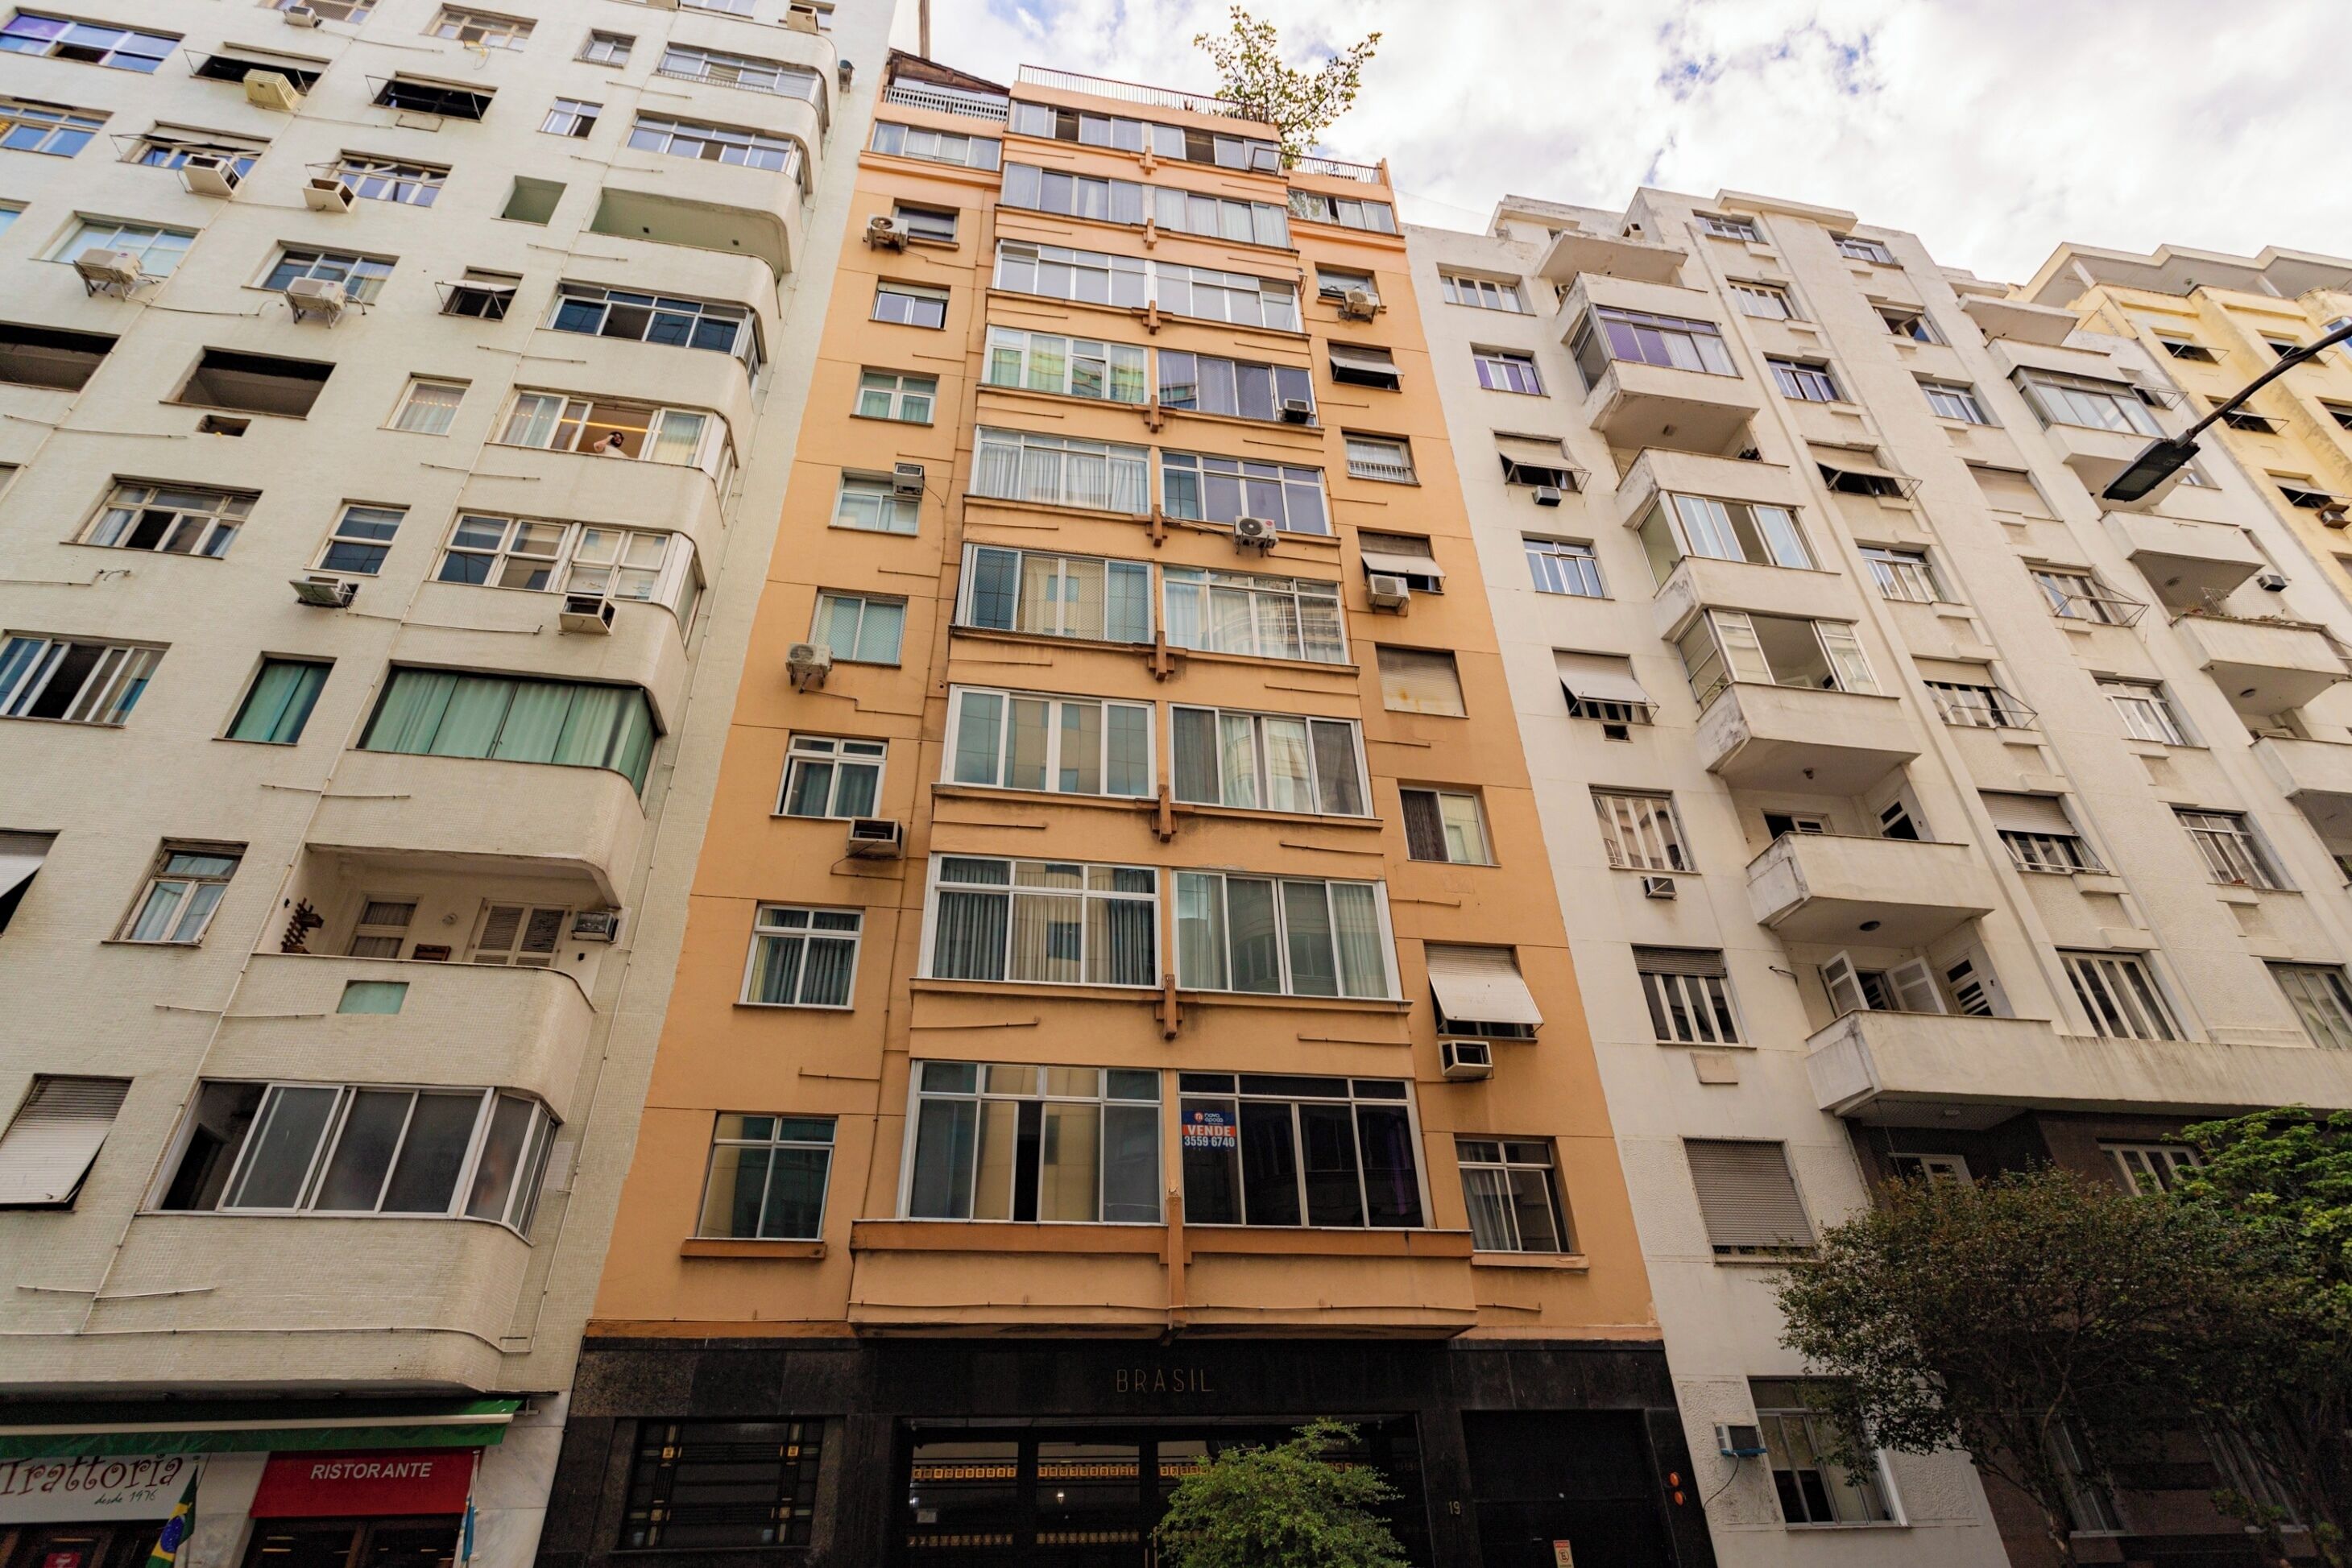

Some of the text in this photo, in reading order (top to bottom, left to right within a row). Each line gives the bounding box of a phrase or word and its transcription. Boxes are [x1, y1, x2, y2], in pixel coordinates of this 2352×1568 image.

[1187, 1125, 1231, 1136] VENDE
[1116, 1369, 1213, 1392] BRASIL
[0, 1454, 183, 1496] Trattoria
[310, 1463, 433, 1479] RISTORANTE
[94, 1488, 159, 1505] desde 1976
[1449, 1501, 1460, 1514] 19
